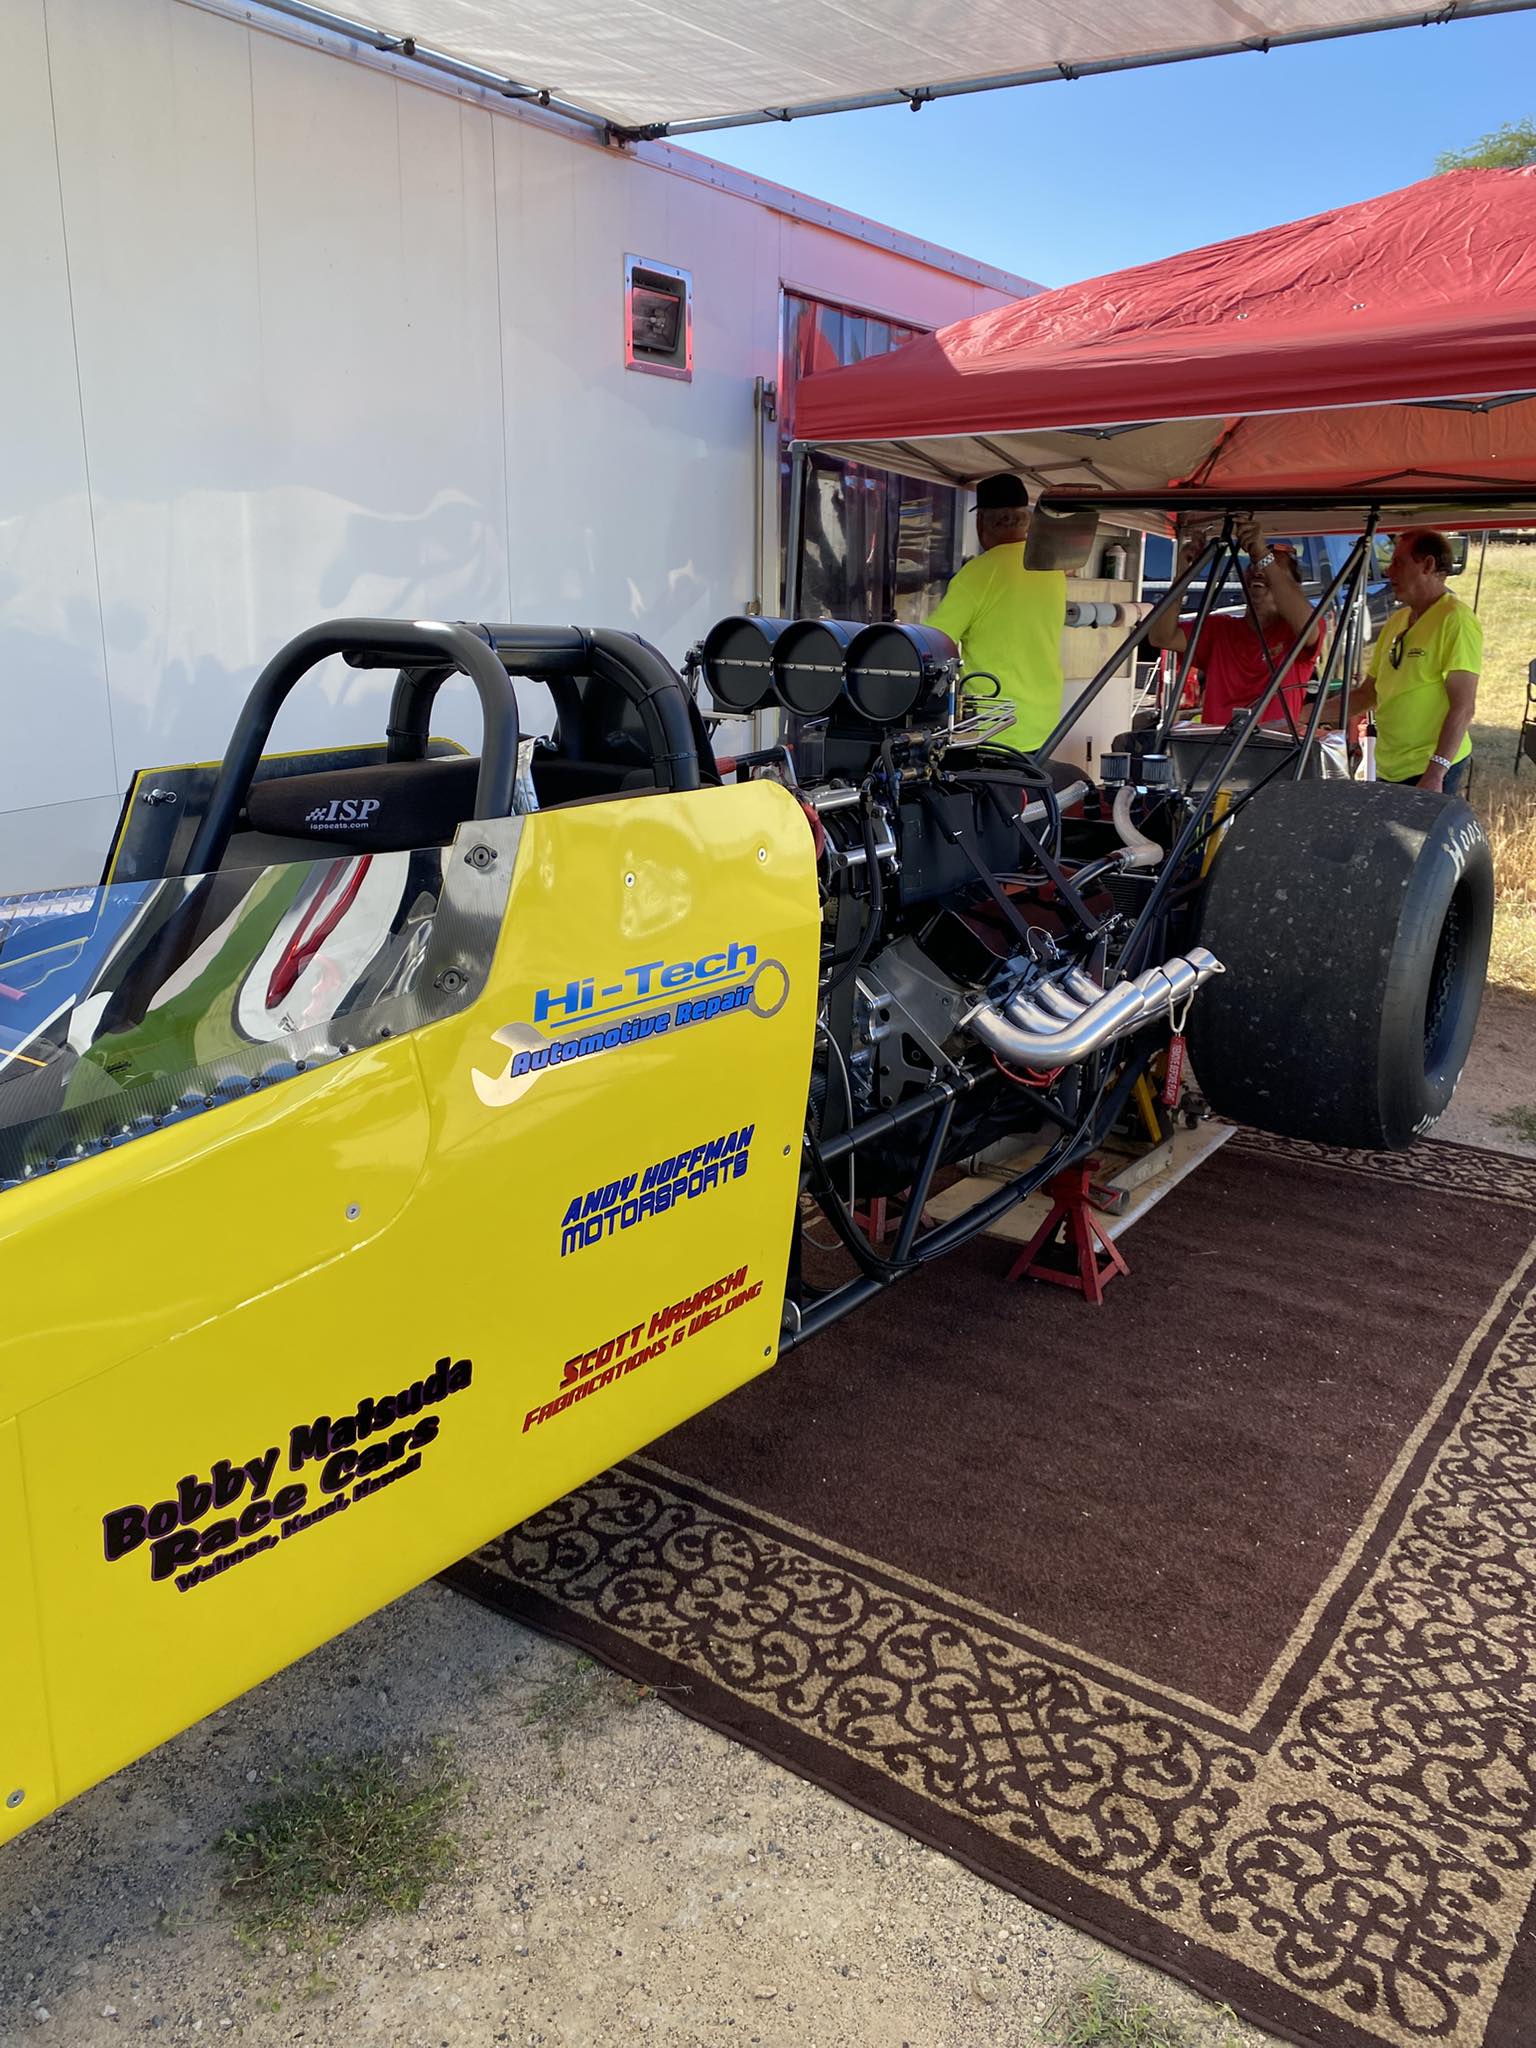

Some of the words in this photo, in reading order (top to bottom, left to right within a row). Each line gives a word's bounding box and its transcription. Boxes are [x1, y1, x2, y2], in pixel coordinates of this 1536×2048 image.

[310, 822, 369, 831] ispseats.com
[325, 799, 381, 821] ISP
[510, 1010, 671, 1078] Automotive
[675, 984, 755, 1026] Repair
[533, 942, 757, 1023] Hi-Tech
[560, 1149, 749, 1258] MOTORSPORTS
[561, 1173, 638, 1227] ANDY
[639, 1123, 755, 1193] HOFFMAN
[521, 1334, 670, 1434] FABRICATIONS
[688, 1280, 764, 1338] WELDING
[559, 1322, 646, 1391] SCOTT
[647, 1264, 749, 1340] HAYASHI
[102, 1447, 280, 1562] Bobby
[289, 1356, 473, 1471] Matsuda
[150, 1483, 308, 1582] Race
[320, 1415, 440, 1494] Cars
[174, 1535, 280, 1593] Waimea,
[281, 1492, 351, 1540] Kauai,
[352, 1452, 422, 1503] Hawaii
